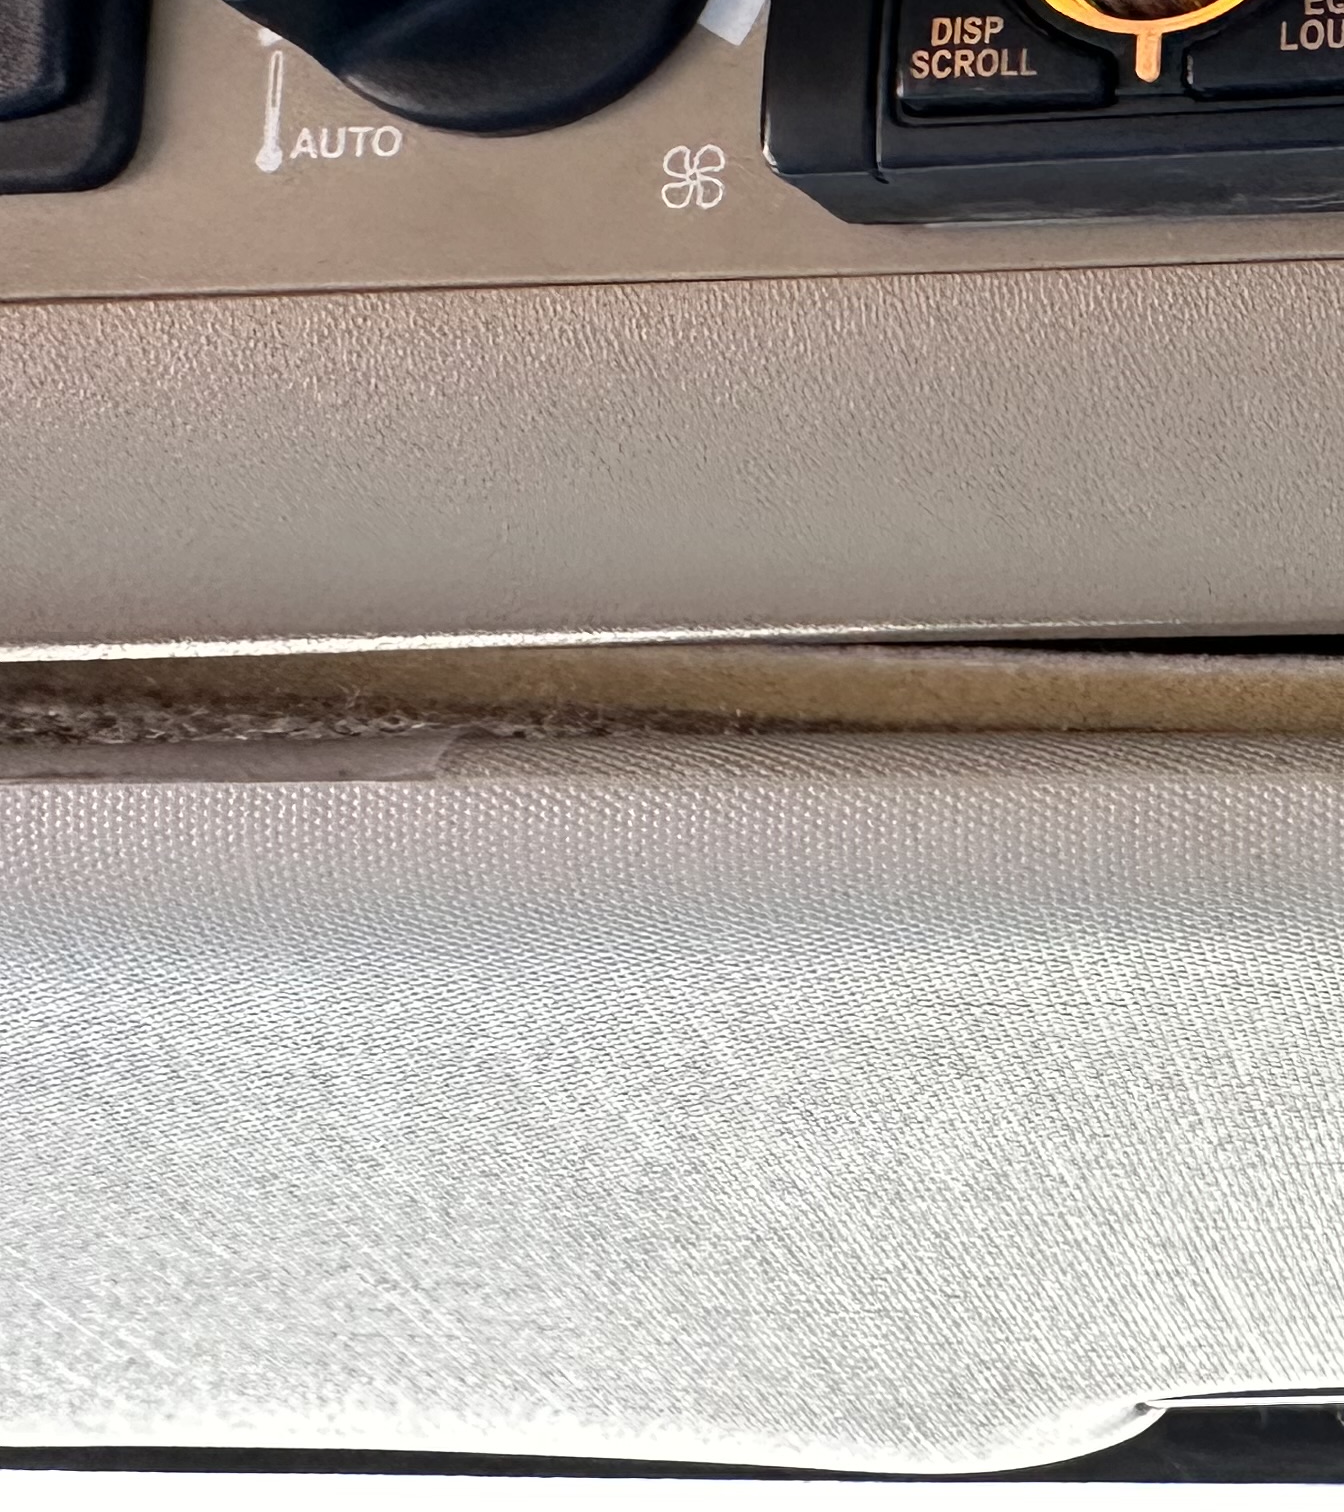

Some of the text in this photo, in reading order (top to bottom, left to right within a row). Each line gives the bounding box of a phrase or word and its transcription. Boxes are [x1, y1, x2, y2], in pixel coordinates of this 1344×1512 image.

[930, 15, 1005, 47] DISP
[909, 48, 1038, 79] SCROLL
[289, 125, 403, 161] AUTO
